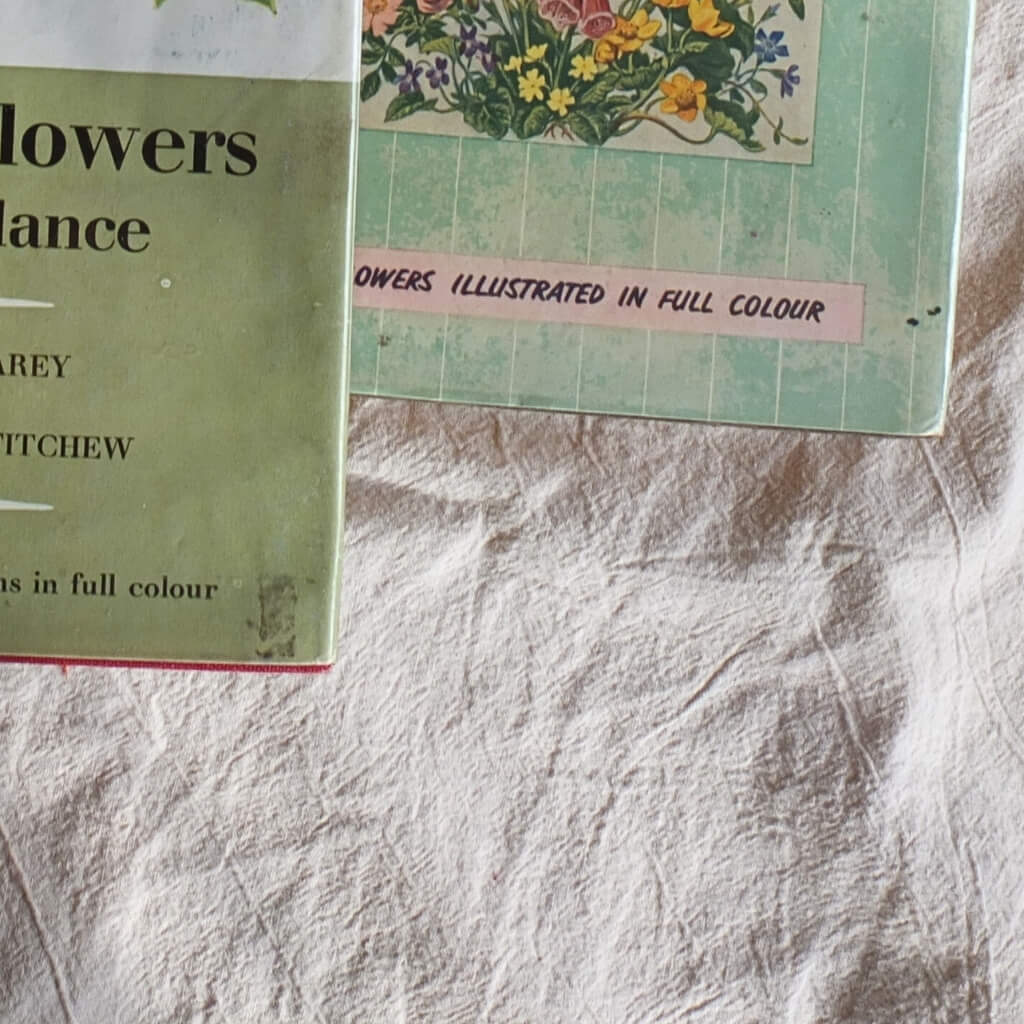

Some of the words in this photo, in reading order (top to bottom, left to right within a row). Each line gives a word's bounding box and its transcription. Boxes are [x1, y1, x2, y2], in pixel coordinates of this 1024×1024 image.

[451, 274, 605, 304] ILLUSTRATED
[618, 286, 648, 308] IN
[658, 290, 713, 313] FULL
[729, 294, 825, 323] COLOUR
[34, 571, 57, 594] in
[72, 572, 115, 596] full
[129, 576, 218, 600] colour
